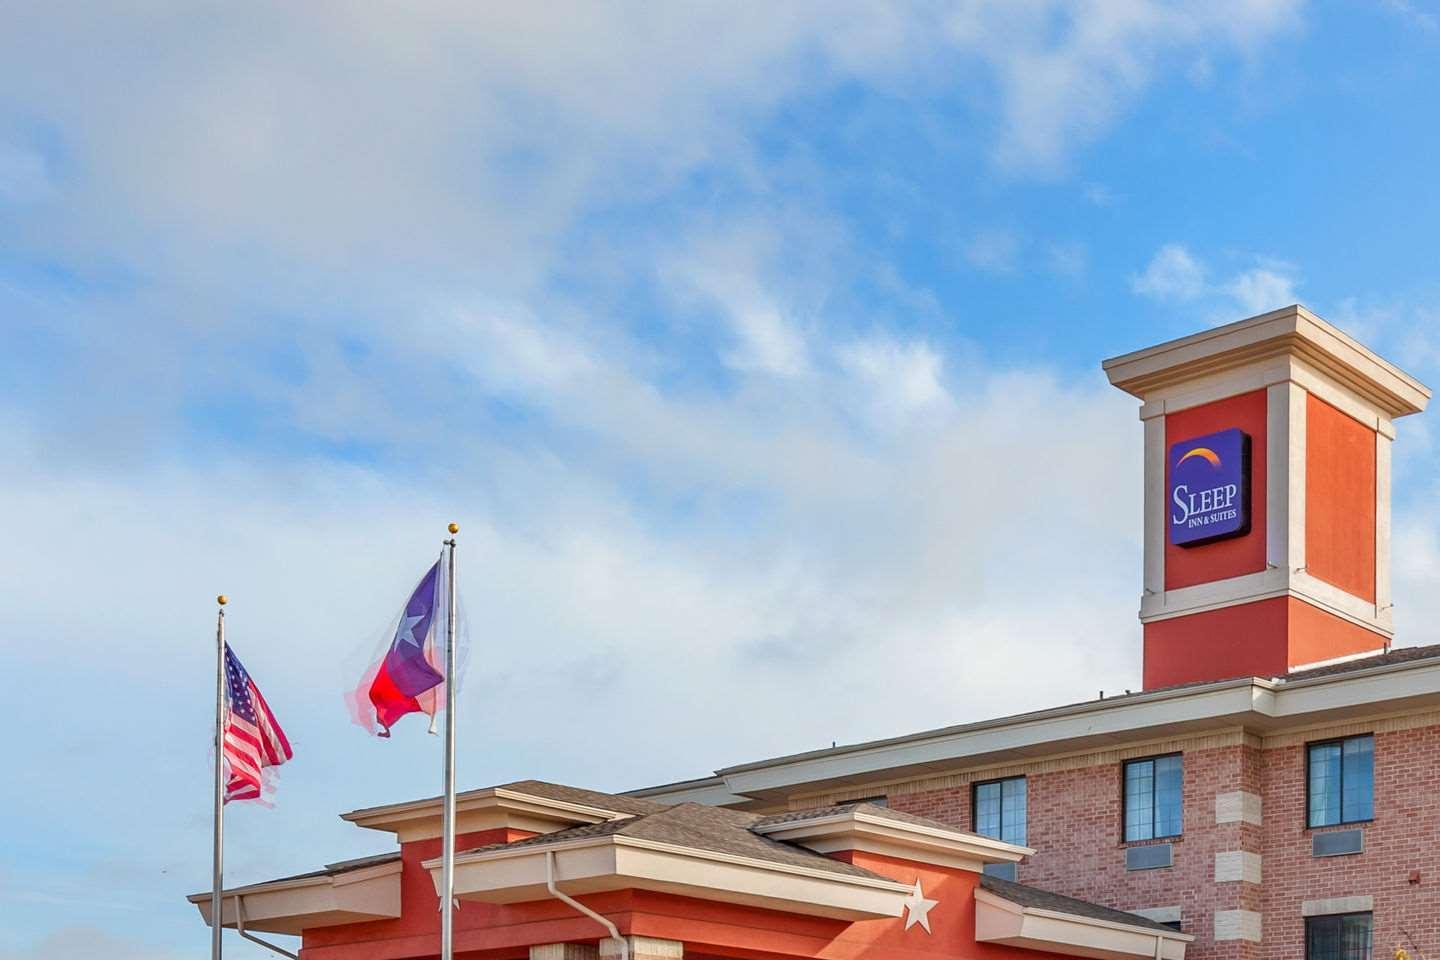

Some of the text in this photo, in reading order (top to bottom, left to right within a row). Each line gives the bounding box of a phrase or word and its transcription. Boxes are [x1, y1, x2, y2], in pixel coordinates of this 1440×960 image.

[1173, 484, 1237, 524] SLEEP
[1188, 509, 1237, 528] INN & SUITES
